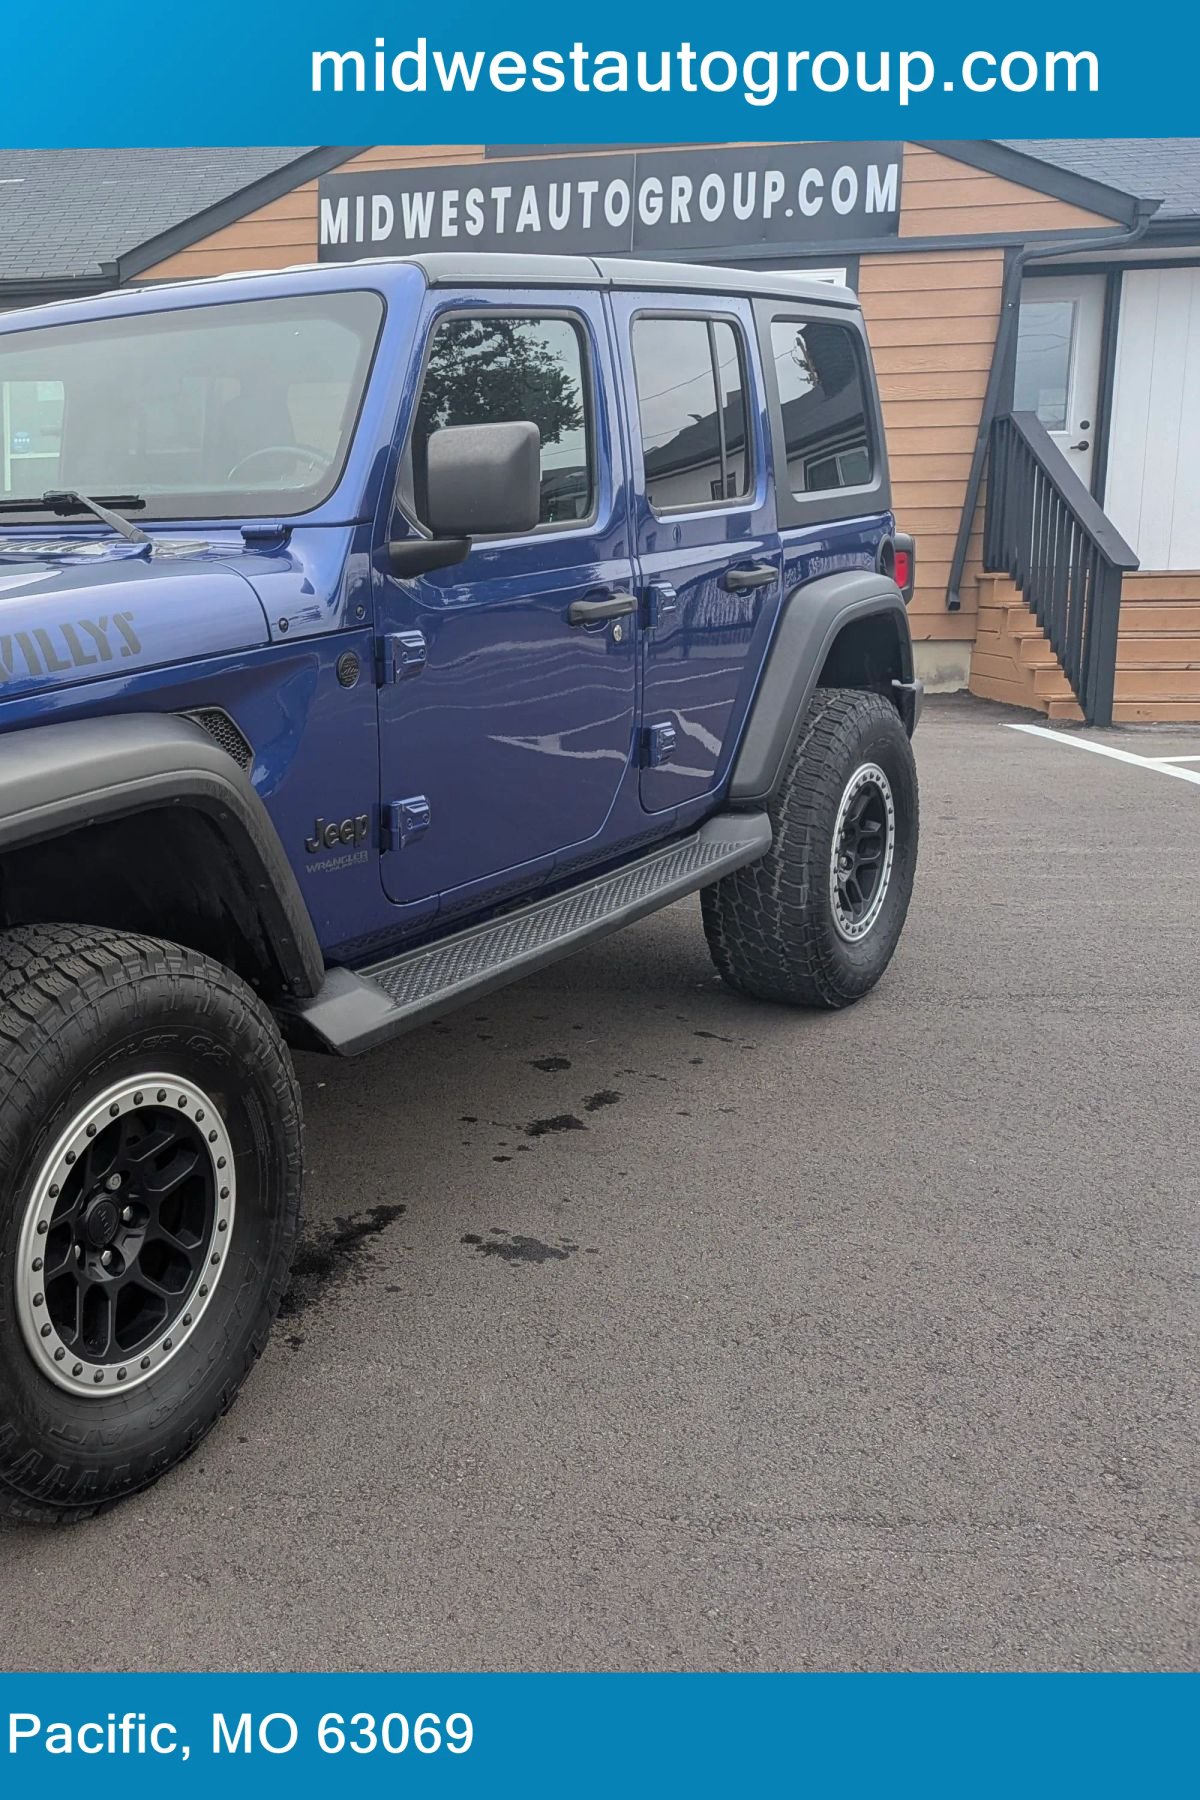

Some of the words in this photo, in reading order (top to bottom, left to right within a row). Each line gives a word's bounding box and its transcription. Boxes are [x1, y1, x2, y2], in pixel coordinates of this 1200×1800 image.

[320, 164, 898, 244] MIDWESTAUTOGROUP.COM
[305, 814, 368, 853] Jeep
[306, 851, 368, 873] WRANGLER
